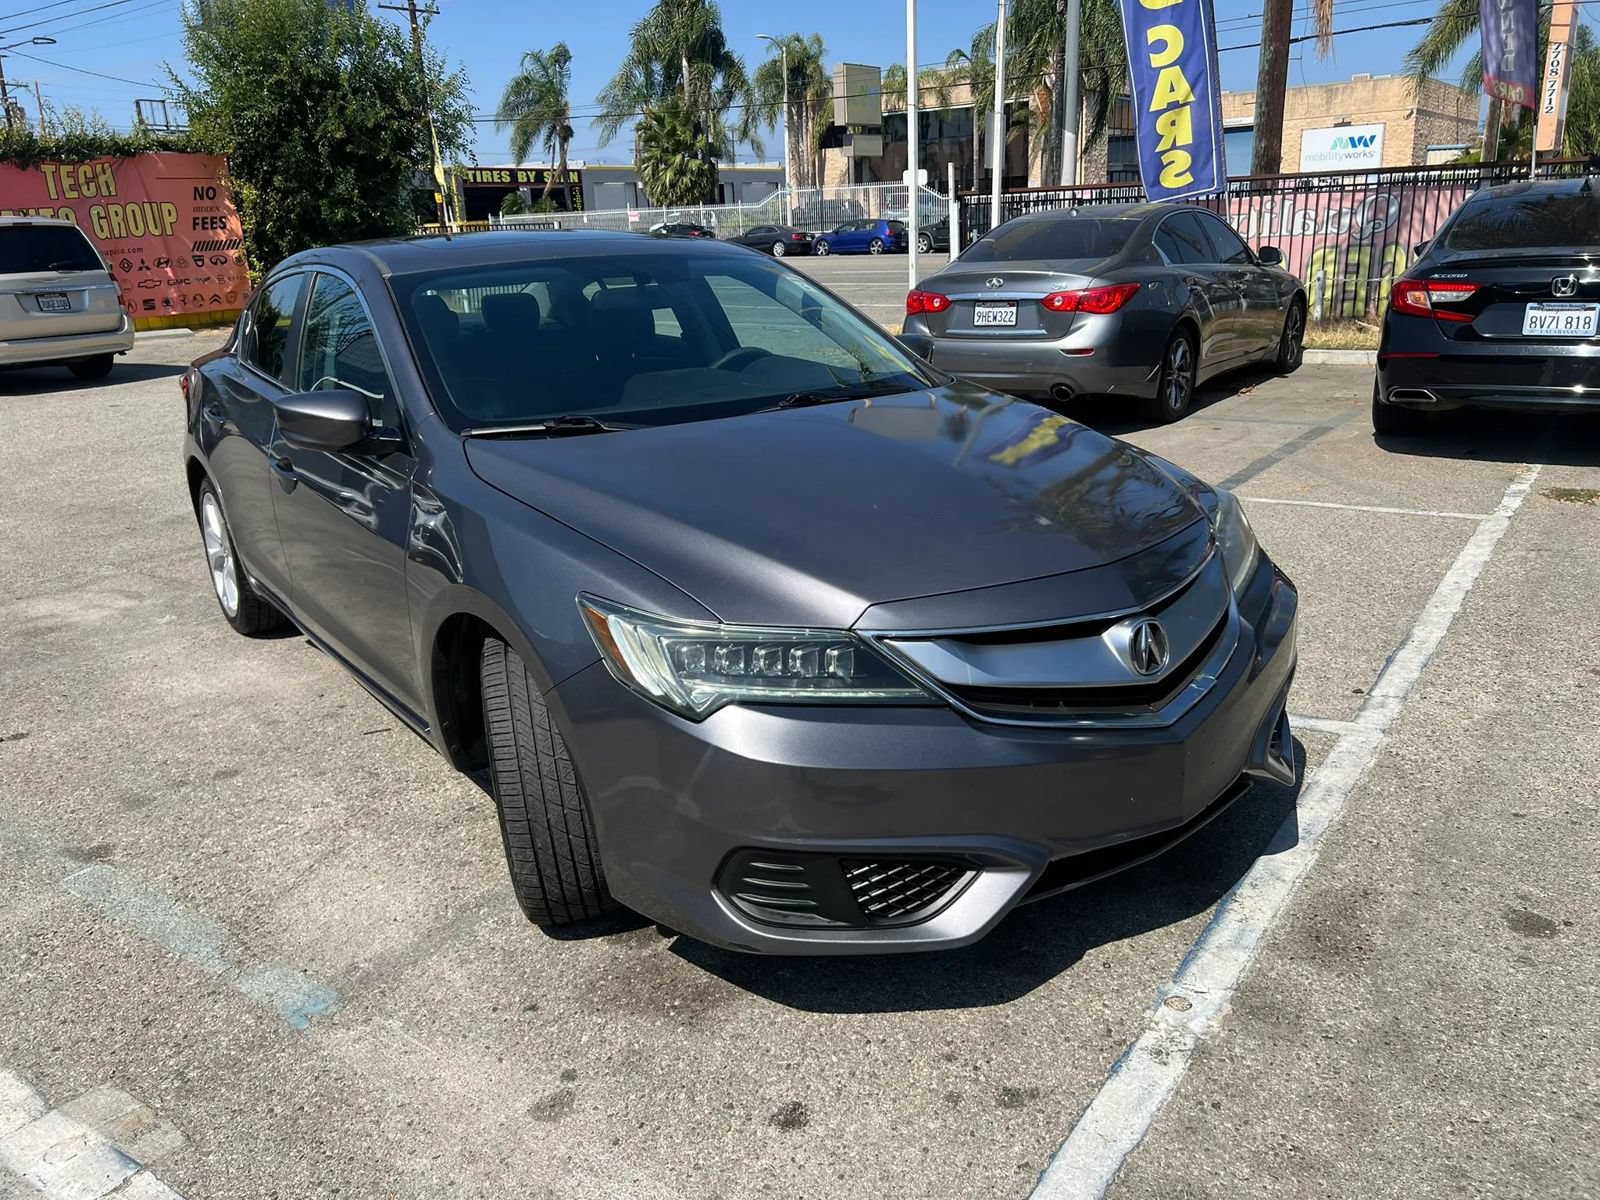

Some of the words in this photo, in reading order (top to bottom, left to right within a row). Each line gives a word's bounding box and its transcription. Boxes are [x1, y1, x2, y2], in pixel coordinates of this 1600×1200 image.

[1305, 149, 1374, 162] mobilityworks
[40, 161, 118, 200] TECH
[467, 170, 510, 183] TIRES
[517, 170, 536, 183] BY
[193, 186, 217, 201] NO
[192, 205, 221, 213] HIDDEN
[89, 201, 179, 241] GROUP
[192, 215, 227, 231] FEES
[167, 278, 191, 286] GMC
[976, 310, 1014, 323] 9HEW322
